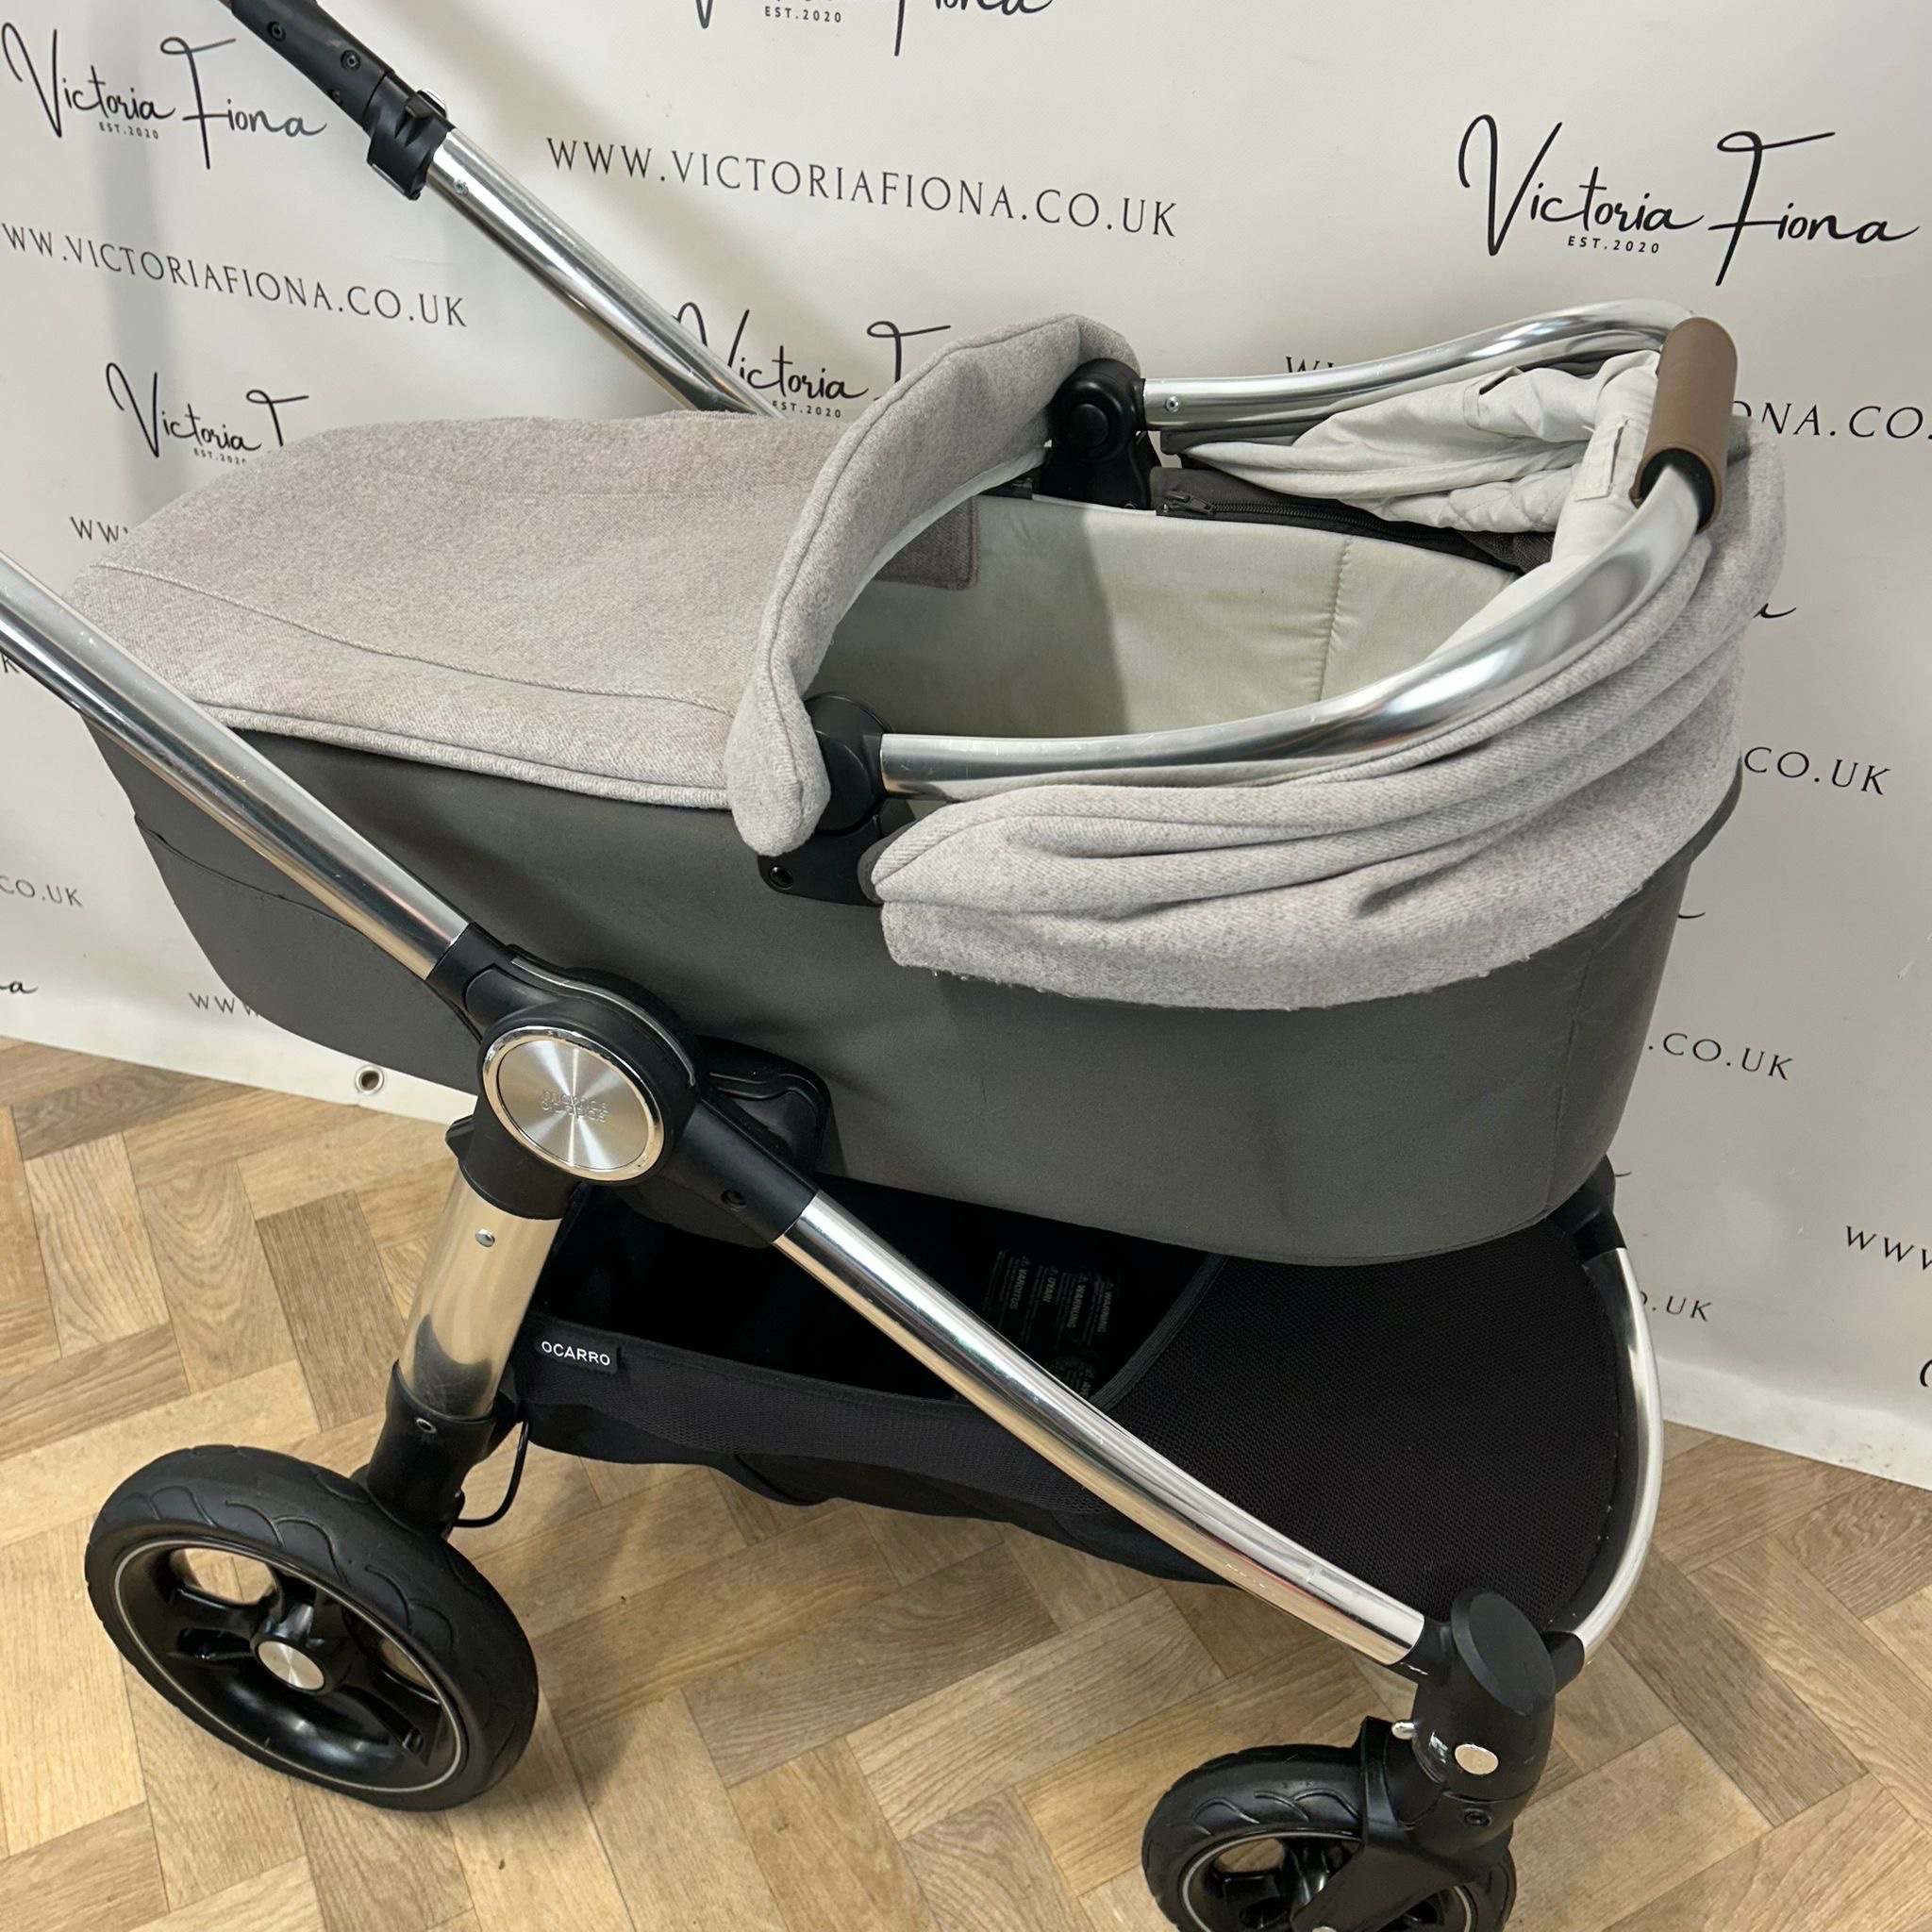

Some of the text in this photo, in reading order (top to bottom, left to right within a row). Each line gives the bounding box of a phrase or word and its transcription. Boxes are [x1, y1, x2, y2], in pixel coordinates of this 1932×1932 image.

[764, 5, 842, 24] EST.2020
[1, 21, 328, 171] Victoria Fiona
[98, 121, 159, 140] EST.2020
[545, 137, 1177, 238] WWW.VICTORIAFIONA.CO.UK
[1457, 113, 1921, 287] Victoria Fiona
[1567, 235, 1660, 255] EST.2020
[105, 361, 262, 459] Victoria
[541, 1341, 611, 1366] OCARRO
